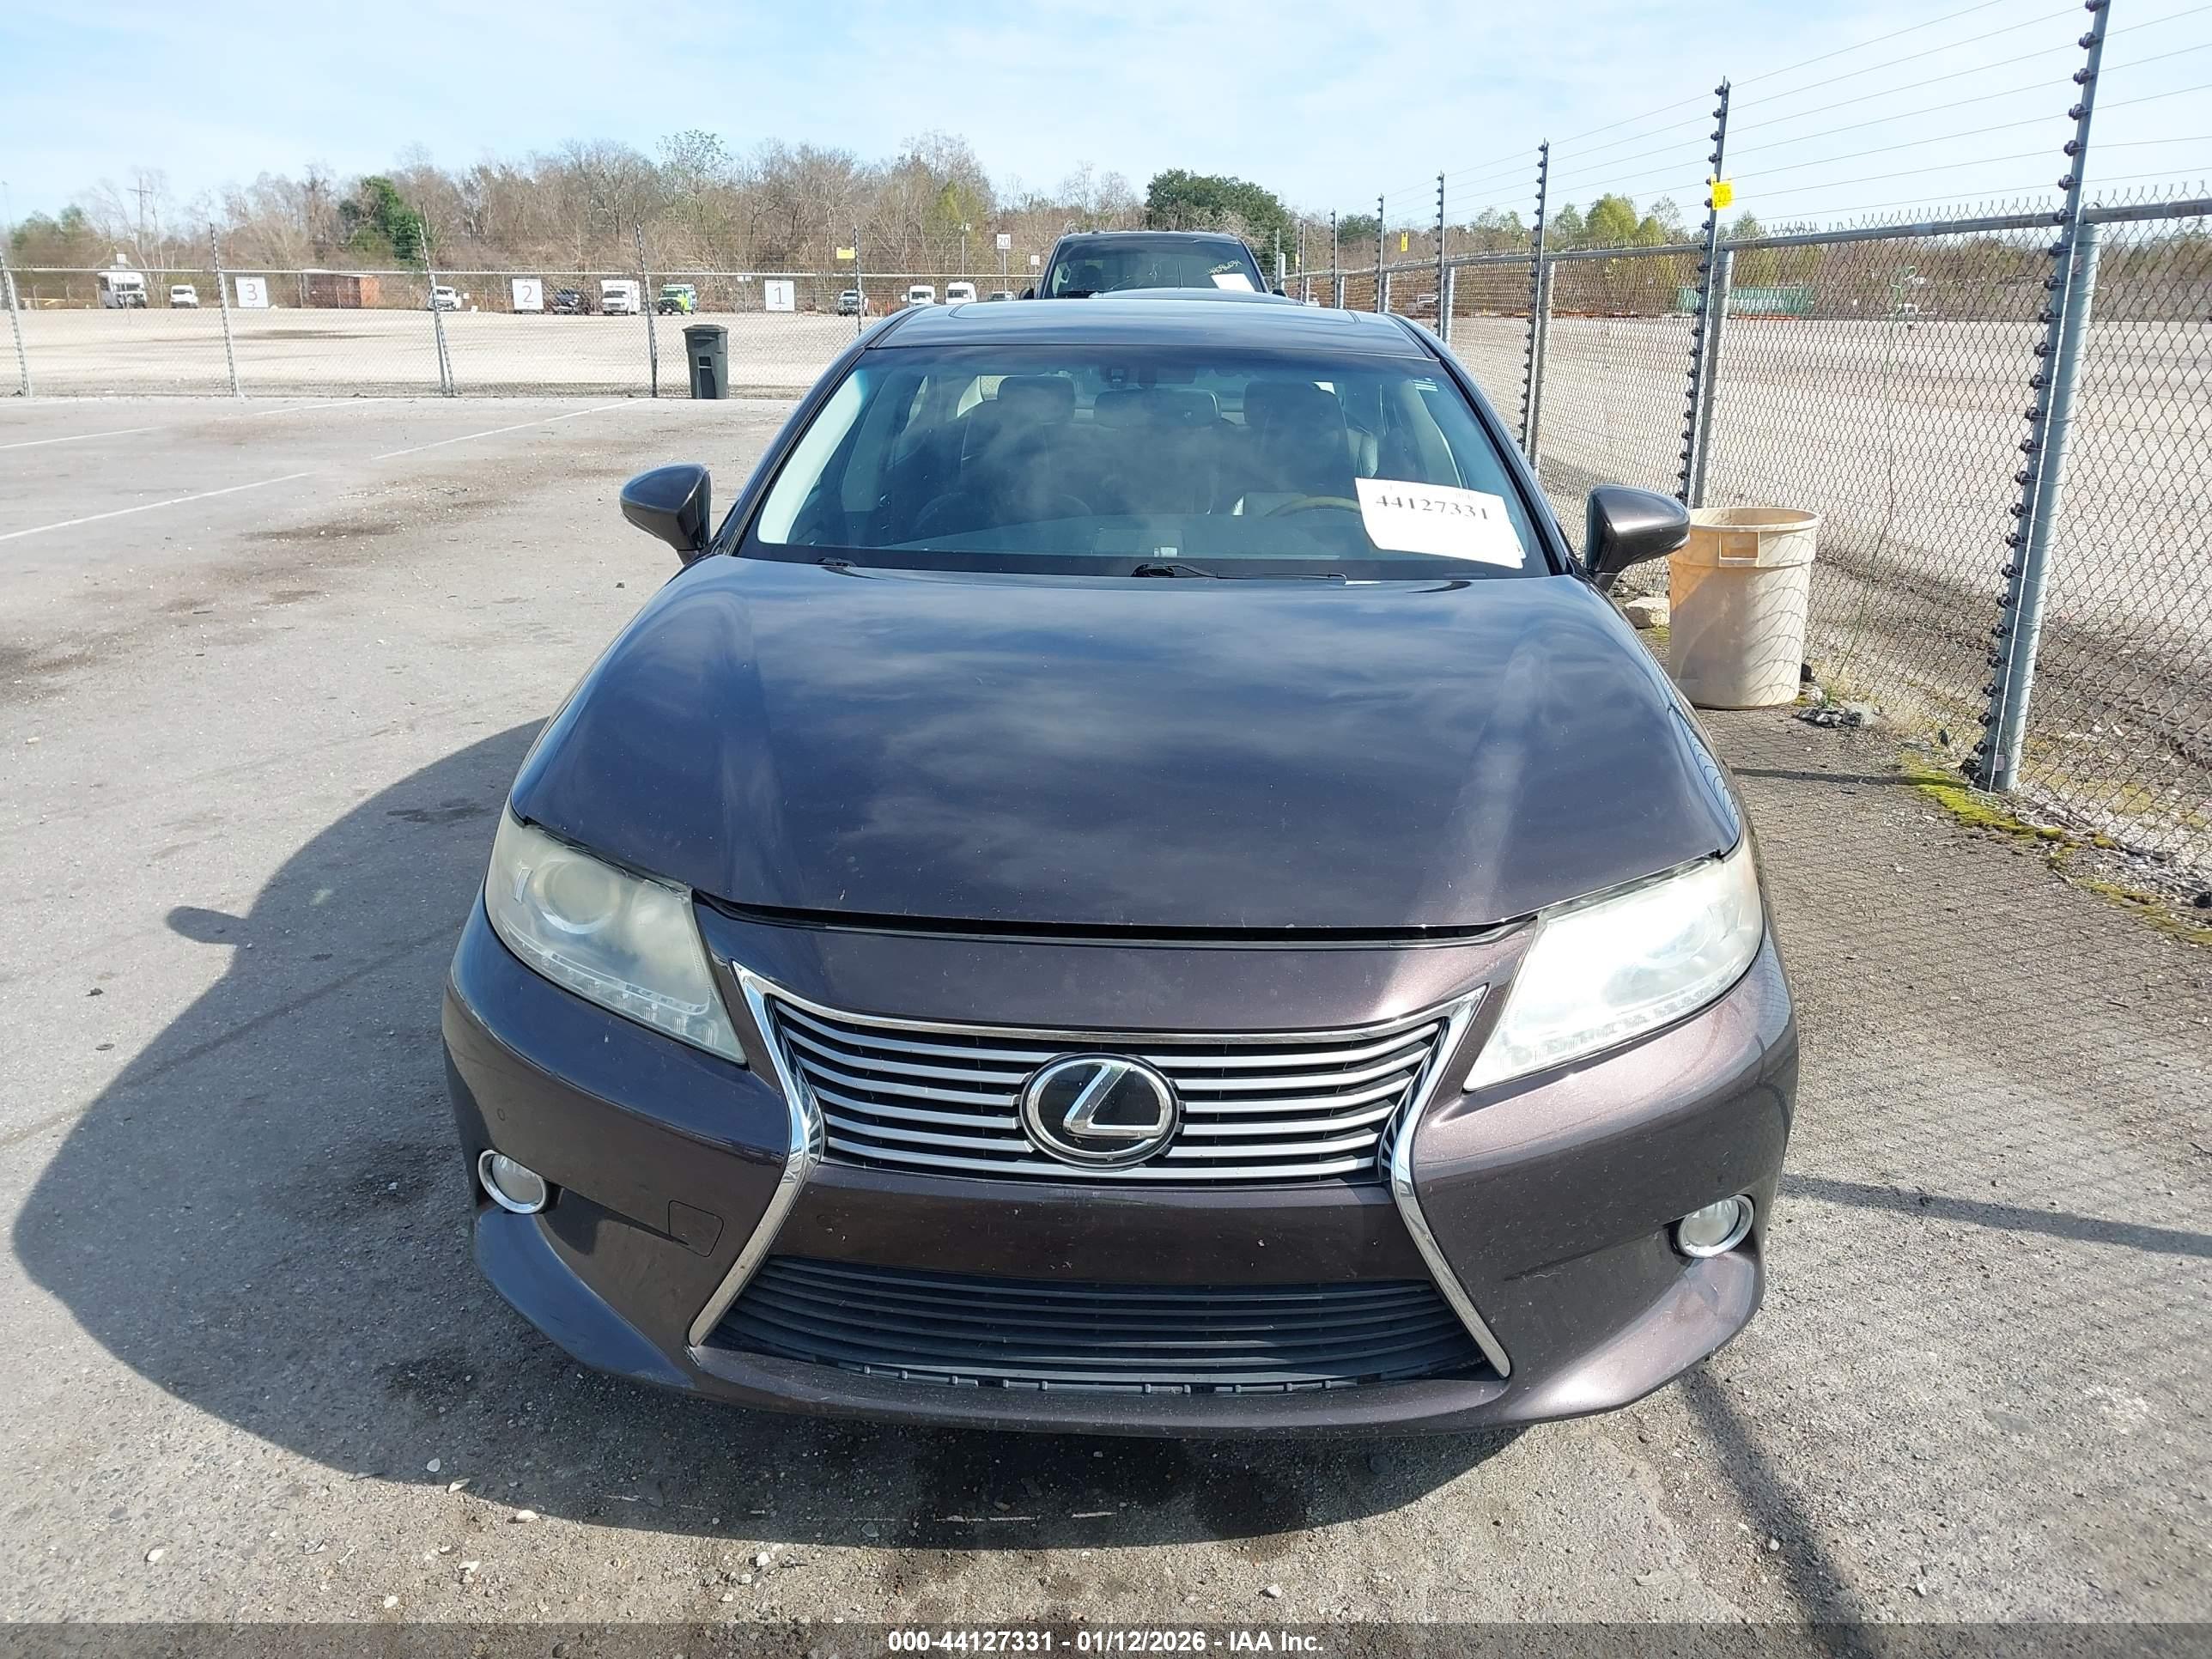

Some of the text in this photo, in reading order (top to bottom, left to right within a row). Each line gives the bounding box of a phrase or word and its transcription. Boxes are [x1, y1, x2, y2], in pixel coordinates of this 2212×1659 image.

[997, 237, 1010, 248] 20
[246, 283, 258, 301] 3
[521, 284, 534, 303] 2
[774, 286, 786, 304] 1
[1376, 495, 1487, 520] 44127331
